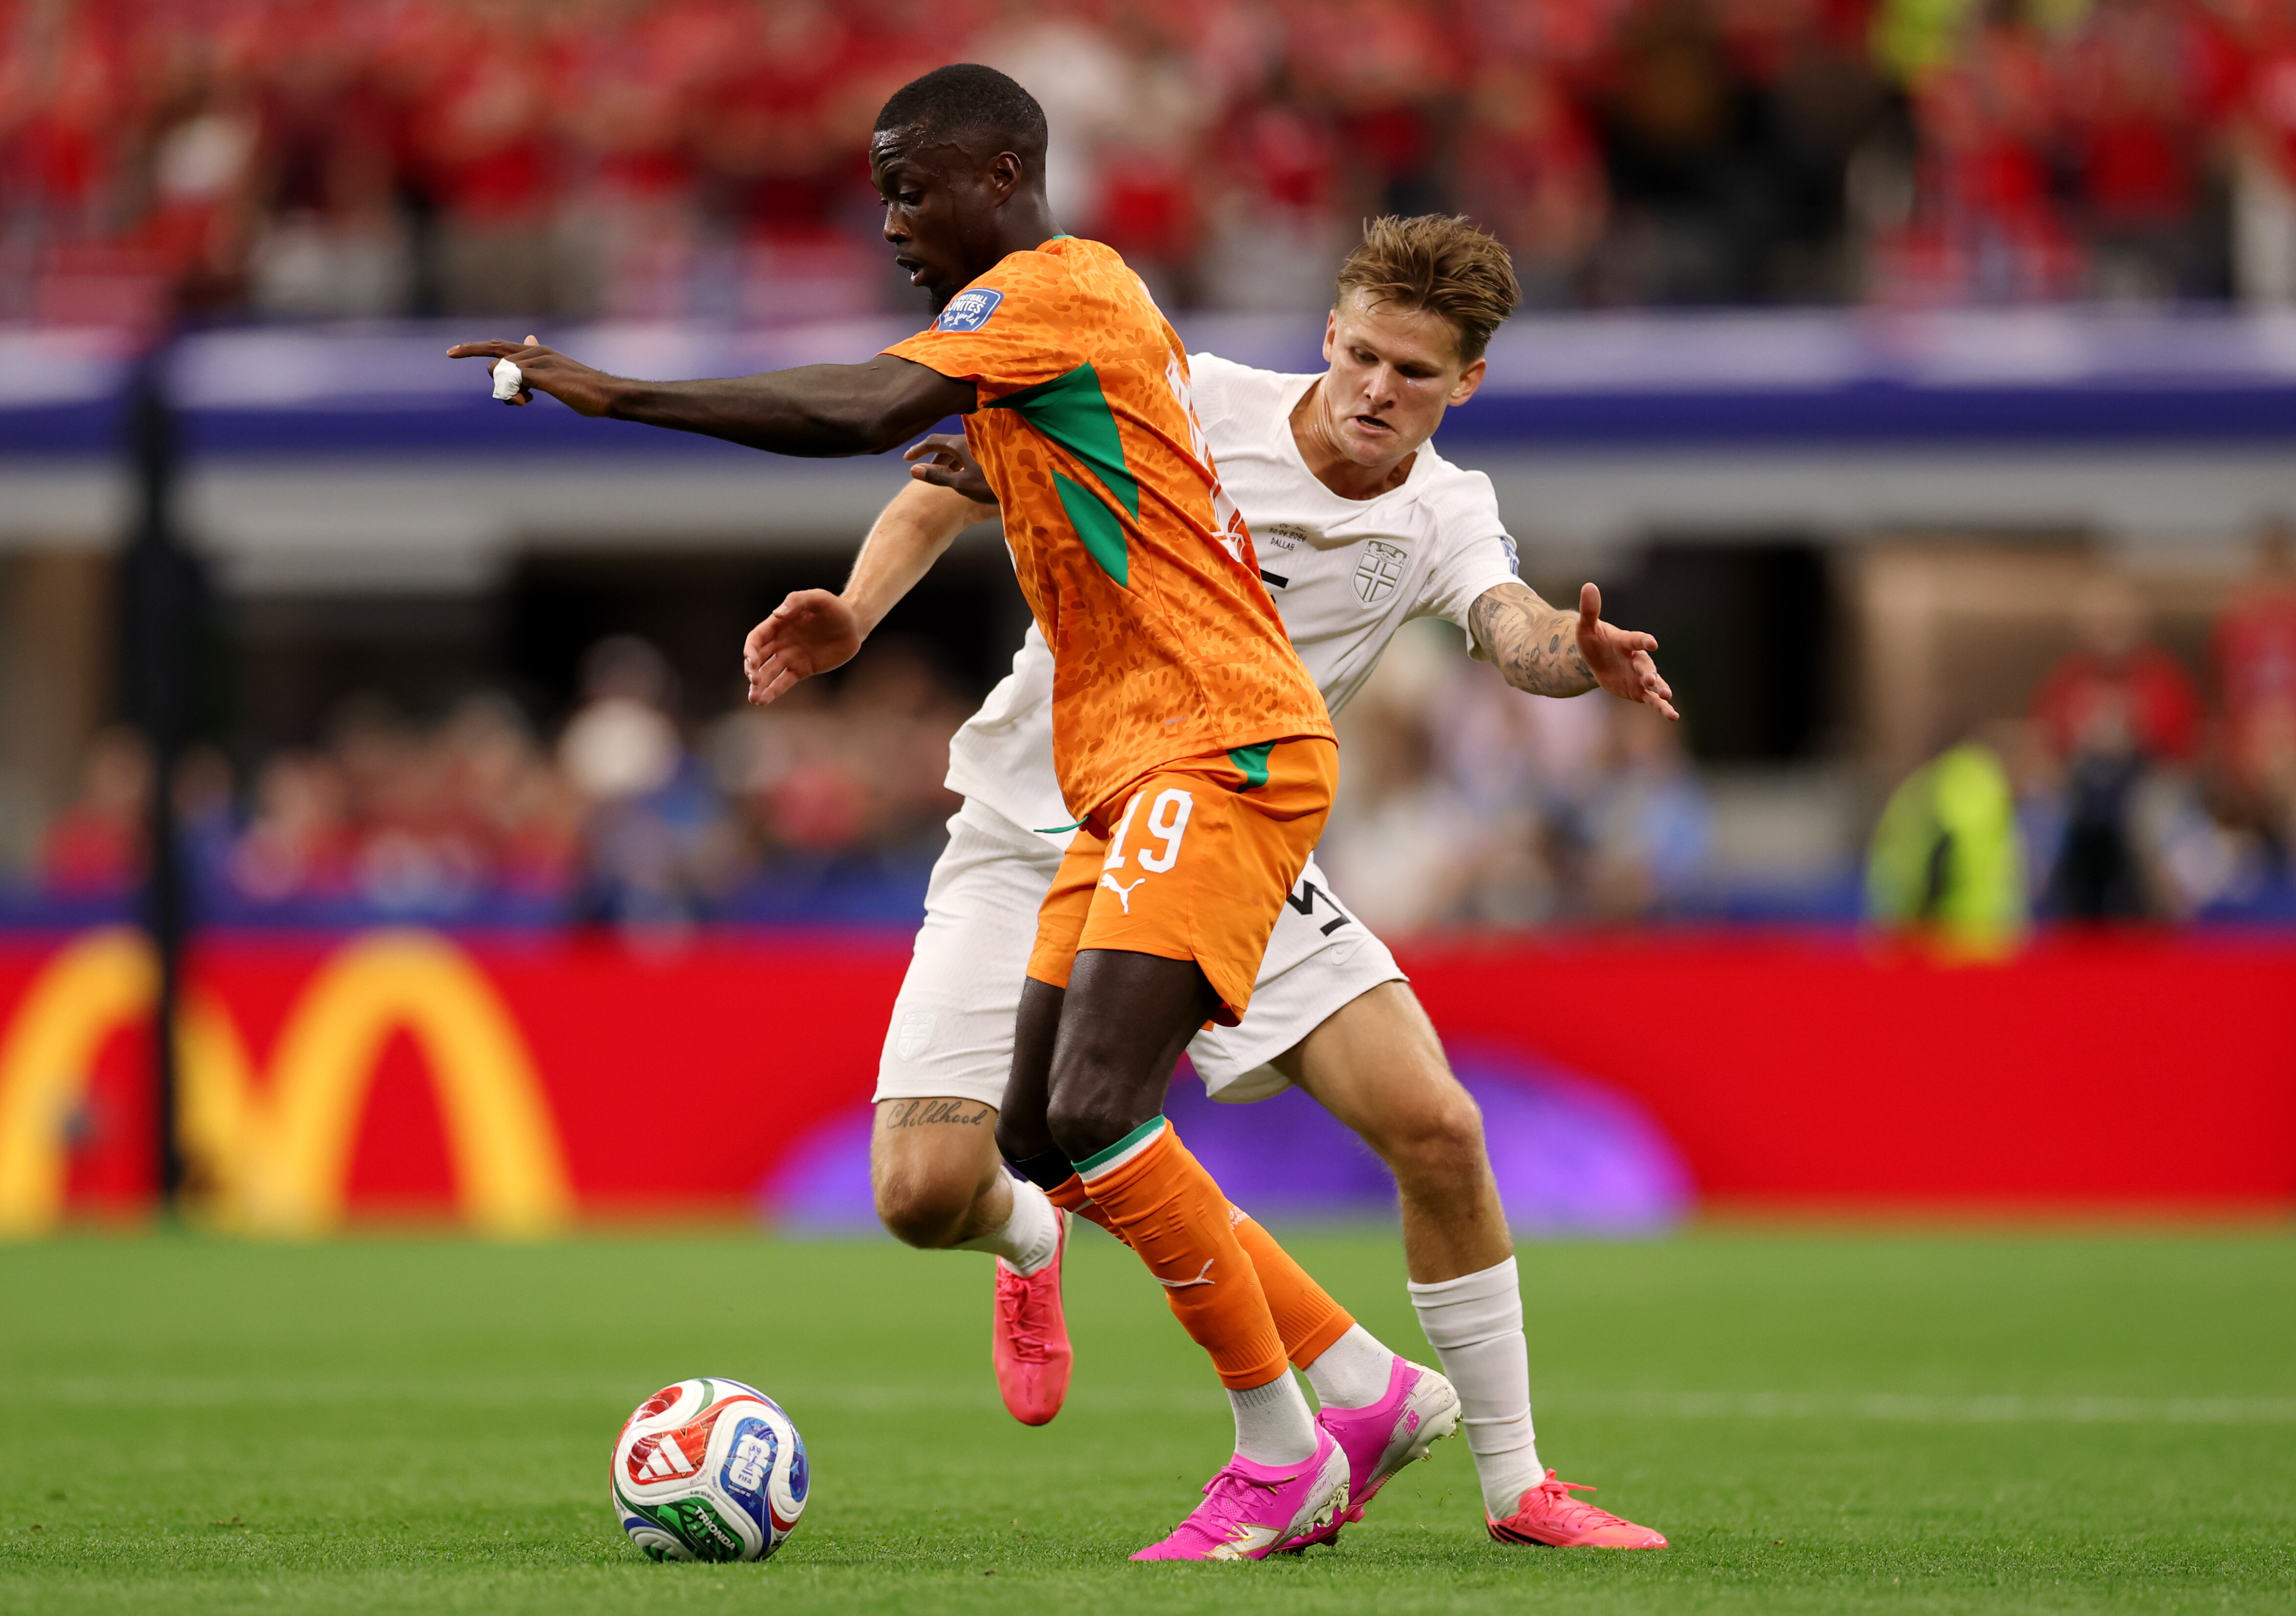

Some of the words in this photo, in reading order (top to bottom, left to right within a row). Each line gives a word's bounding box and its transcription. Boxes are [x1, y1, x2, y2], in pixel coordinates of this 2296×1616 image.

[947, 301, 984, 314] UNITES
[943, 311, 954, 324] the
[1270, 537, 1295, 551] DALLAS
[1102, 788, 1194, 874] 19
[887, 1099, 988, 1129] Childhood
[738, 1474, 751, 1484] FIFA
[695, 1505, 736, 1551] TRIONDA
